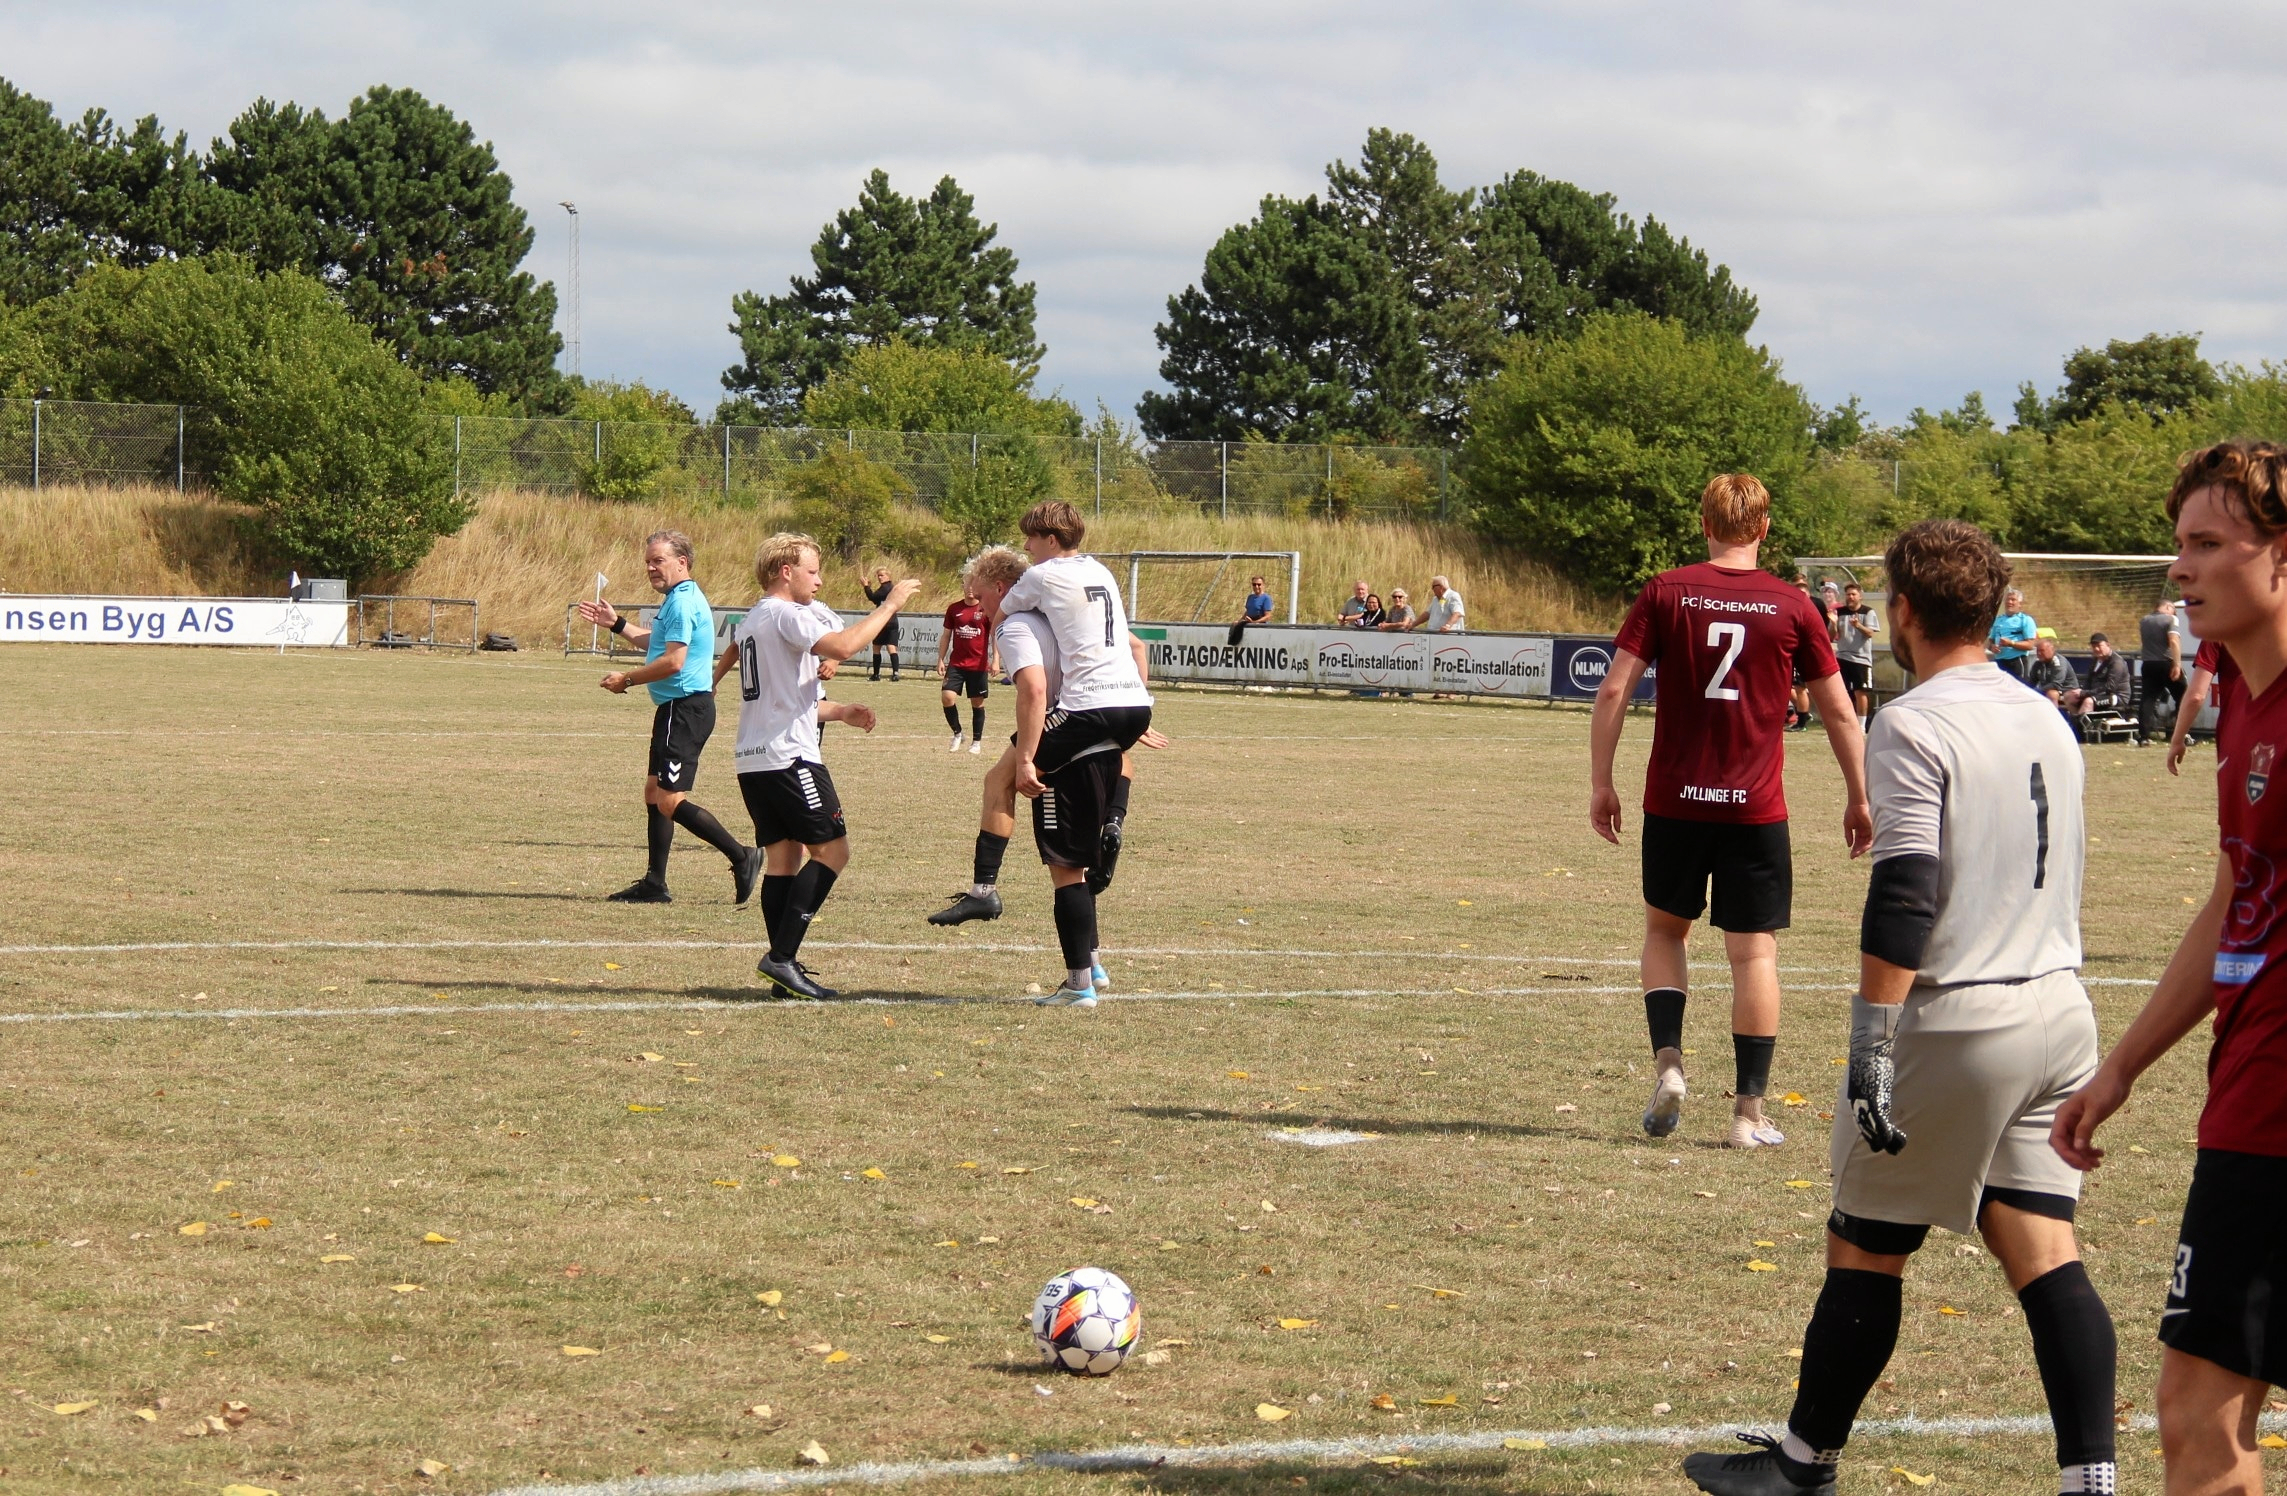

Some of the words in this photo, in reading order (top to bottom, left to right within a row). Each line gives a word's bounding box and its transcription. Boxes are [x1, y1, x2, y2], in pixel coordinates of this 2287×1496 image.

[6, 610, 88, 631] nsen
[102, 605, 165, 639] Byg
[177, 606, 234, 633] A/S
[1083, 585, 1115, 648] 7
[911, 627, 938, 642] Service
[1149, 643, 1288, 671] MR-TAGDÆKNING
[1291, 658, 1309, 674] ApS
[1319, 652, 1418, 671] Pro-ELinstallation
[1433, 657, 1540, 677] Pro-ELinstallation
[1575, 661, 1607, 677] NLMK
[1704, 621, 1746, 701] 2
[1680, 785, 1730, 803] JYLLINGE
[1732, 789, 1747, 804] FC
[2030, 762, 2049, 889] 1
[2172, 1243, 2192, 1298] 3
